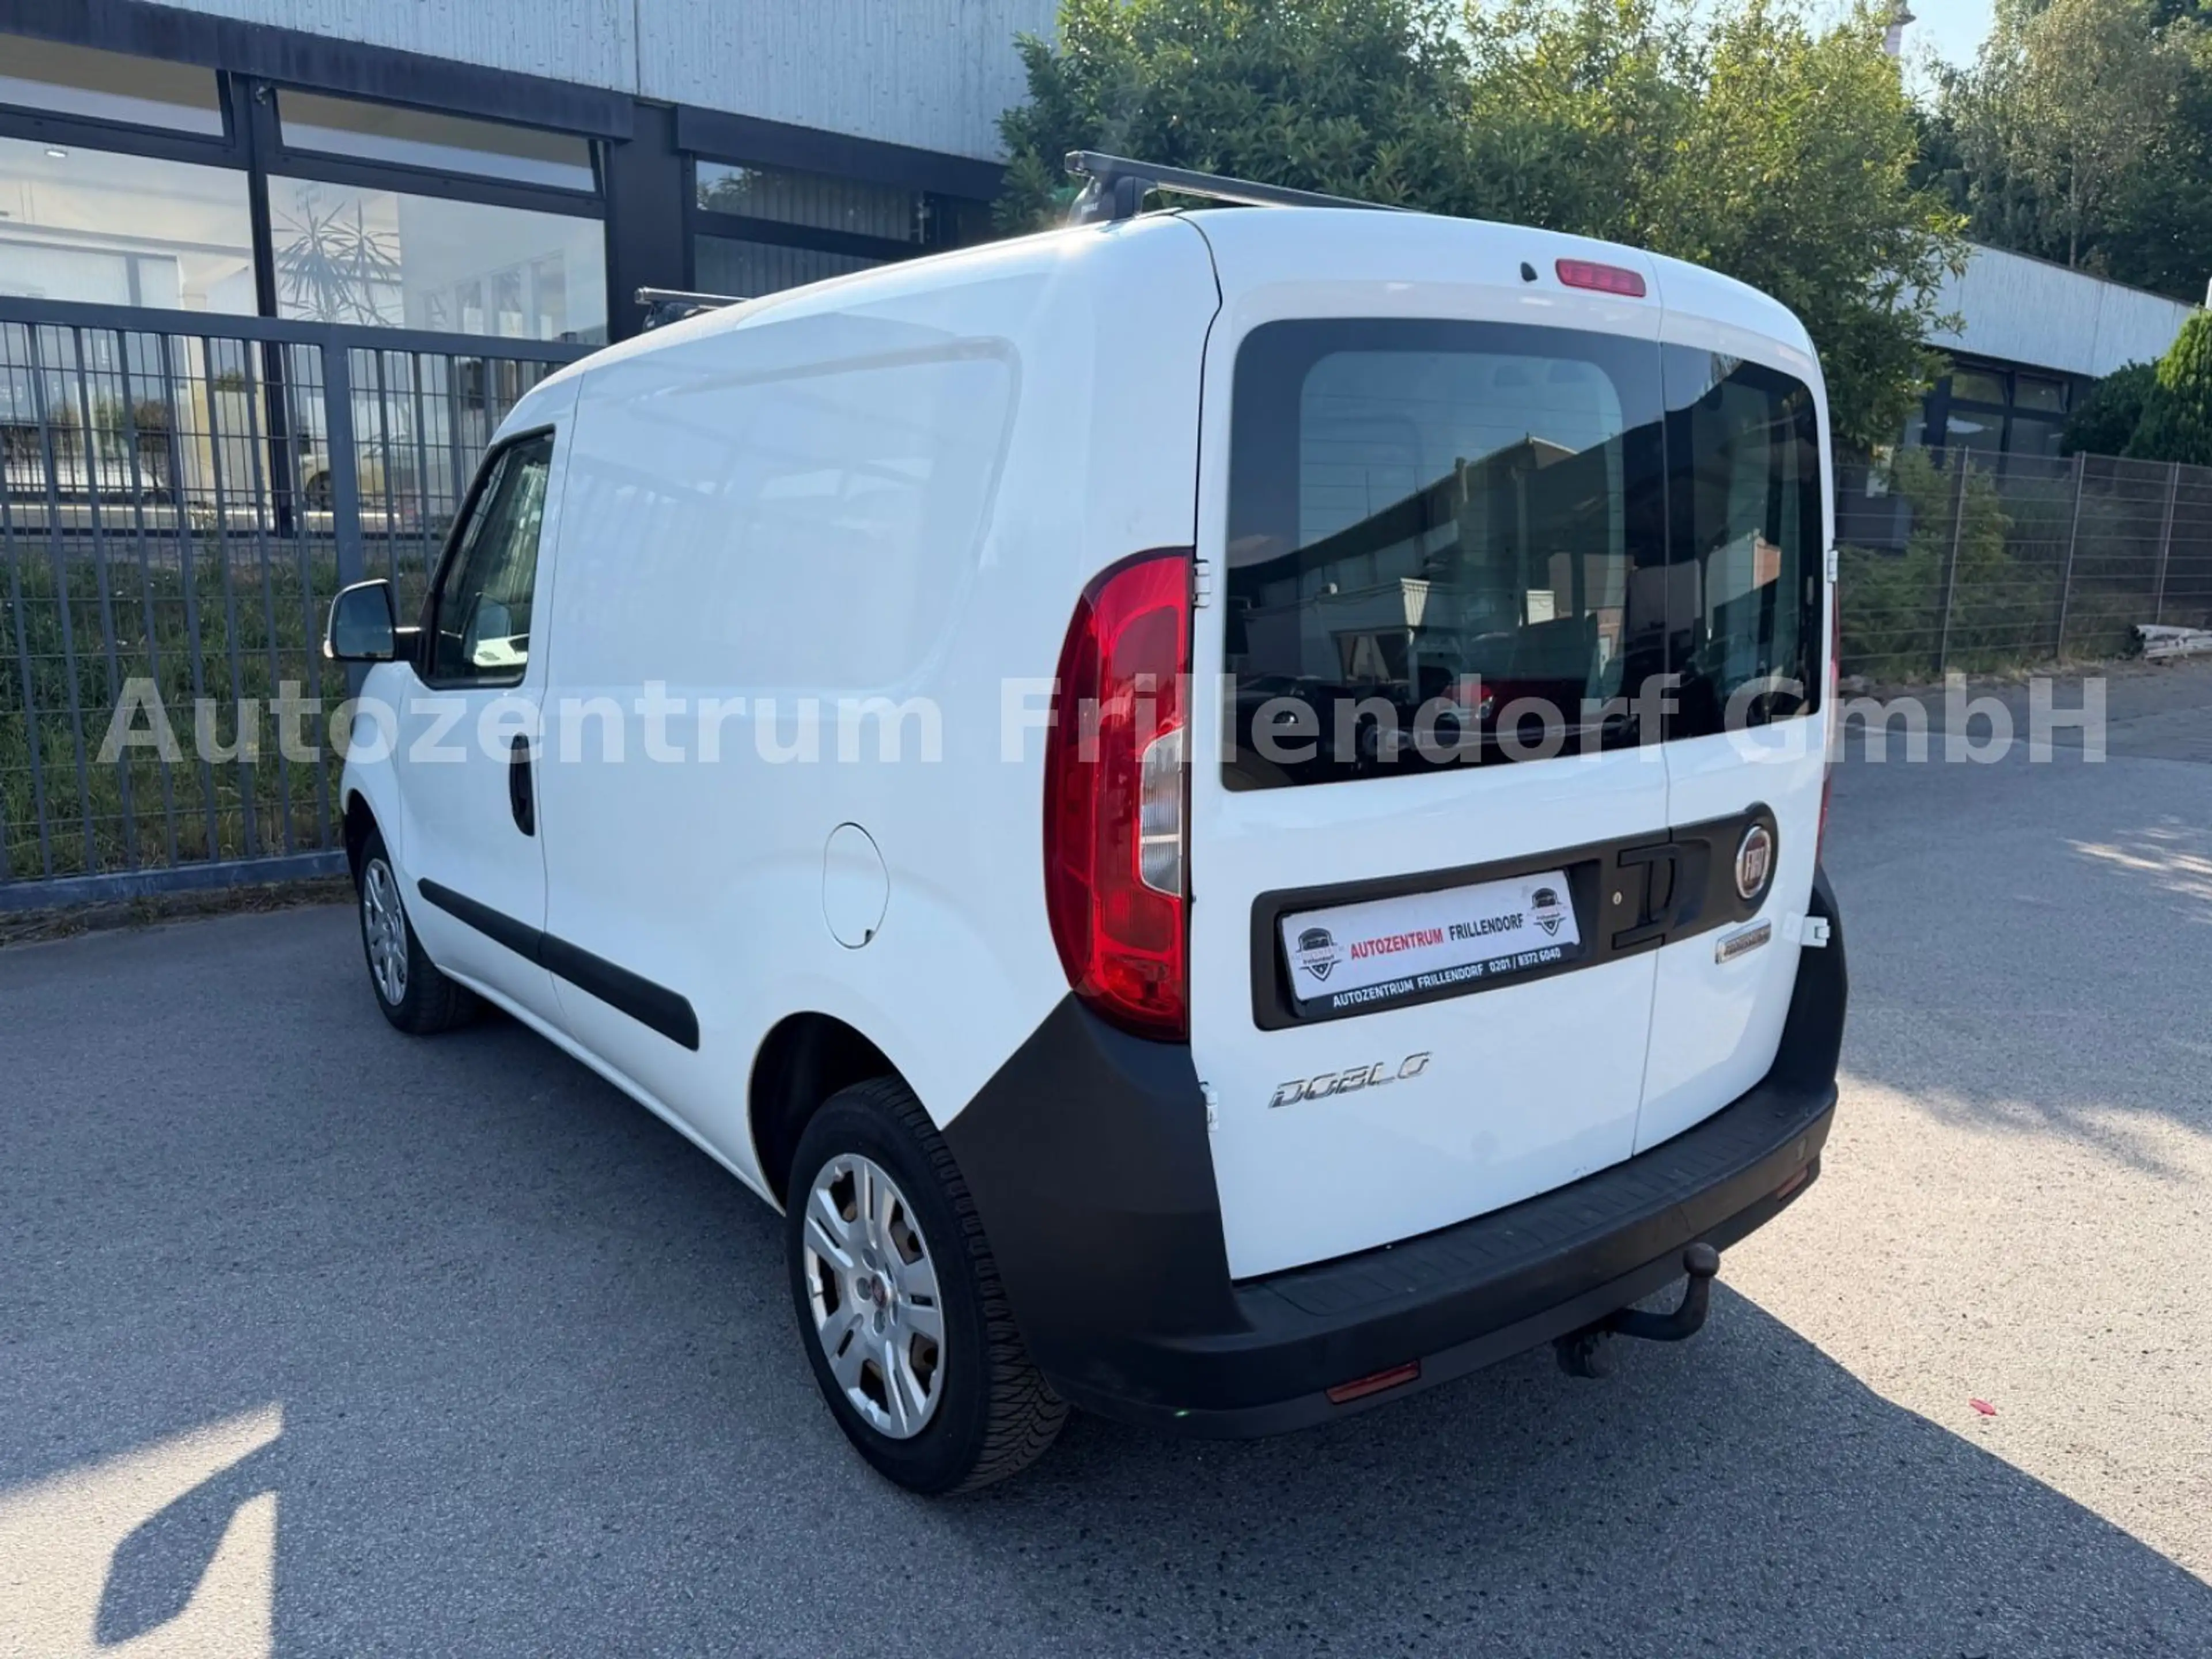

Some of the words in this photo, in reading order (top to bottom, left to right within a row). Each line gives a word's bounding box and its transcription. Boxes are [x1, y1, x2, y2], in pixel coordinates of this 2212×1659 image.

[1350, 927, 1444, 960] AUTOZENTRUM
[1448, 912, 1524, 941] FRILLENDORF
[1332, 979, 1415, 1008] AUTOZENTRUM
[1417, 964, 1484, 990] FRILLENDORF
[1488, 959, 1512, 973] 0201
